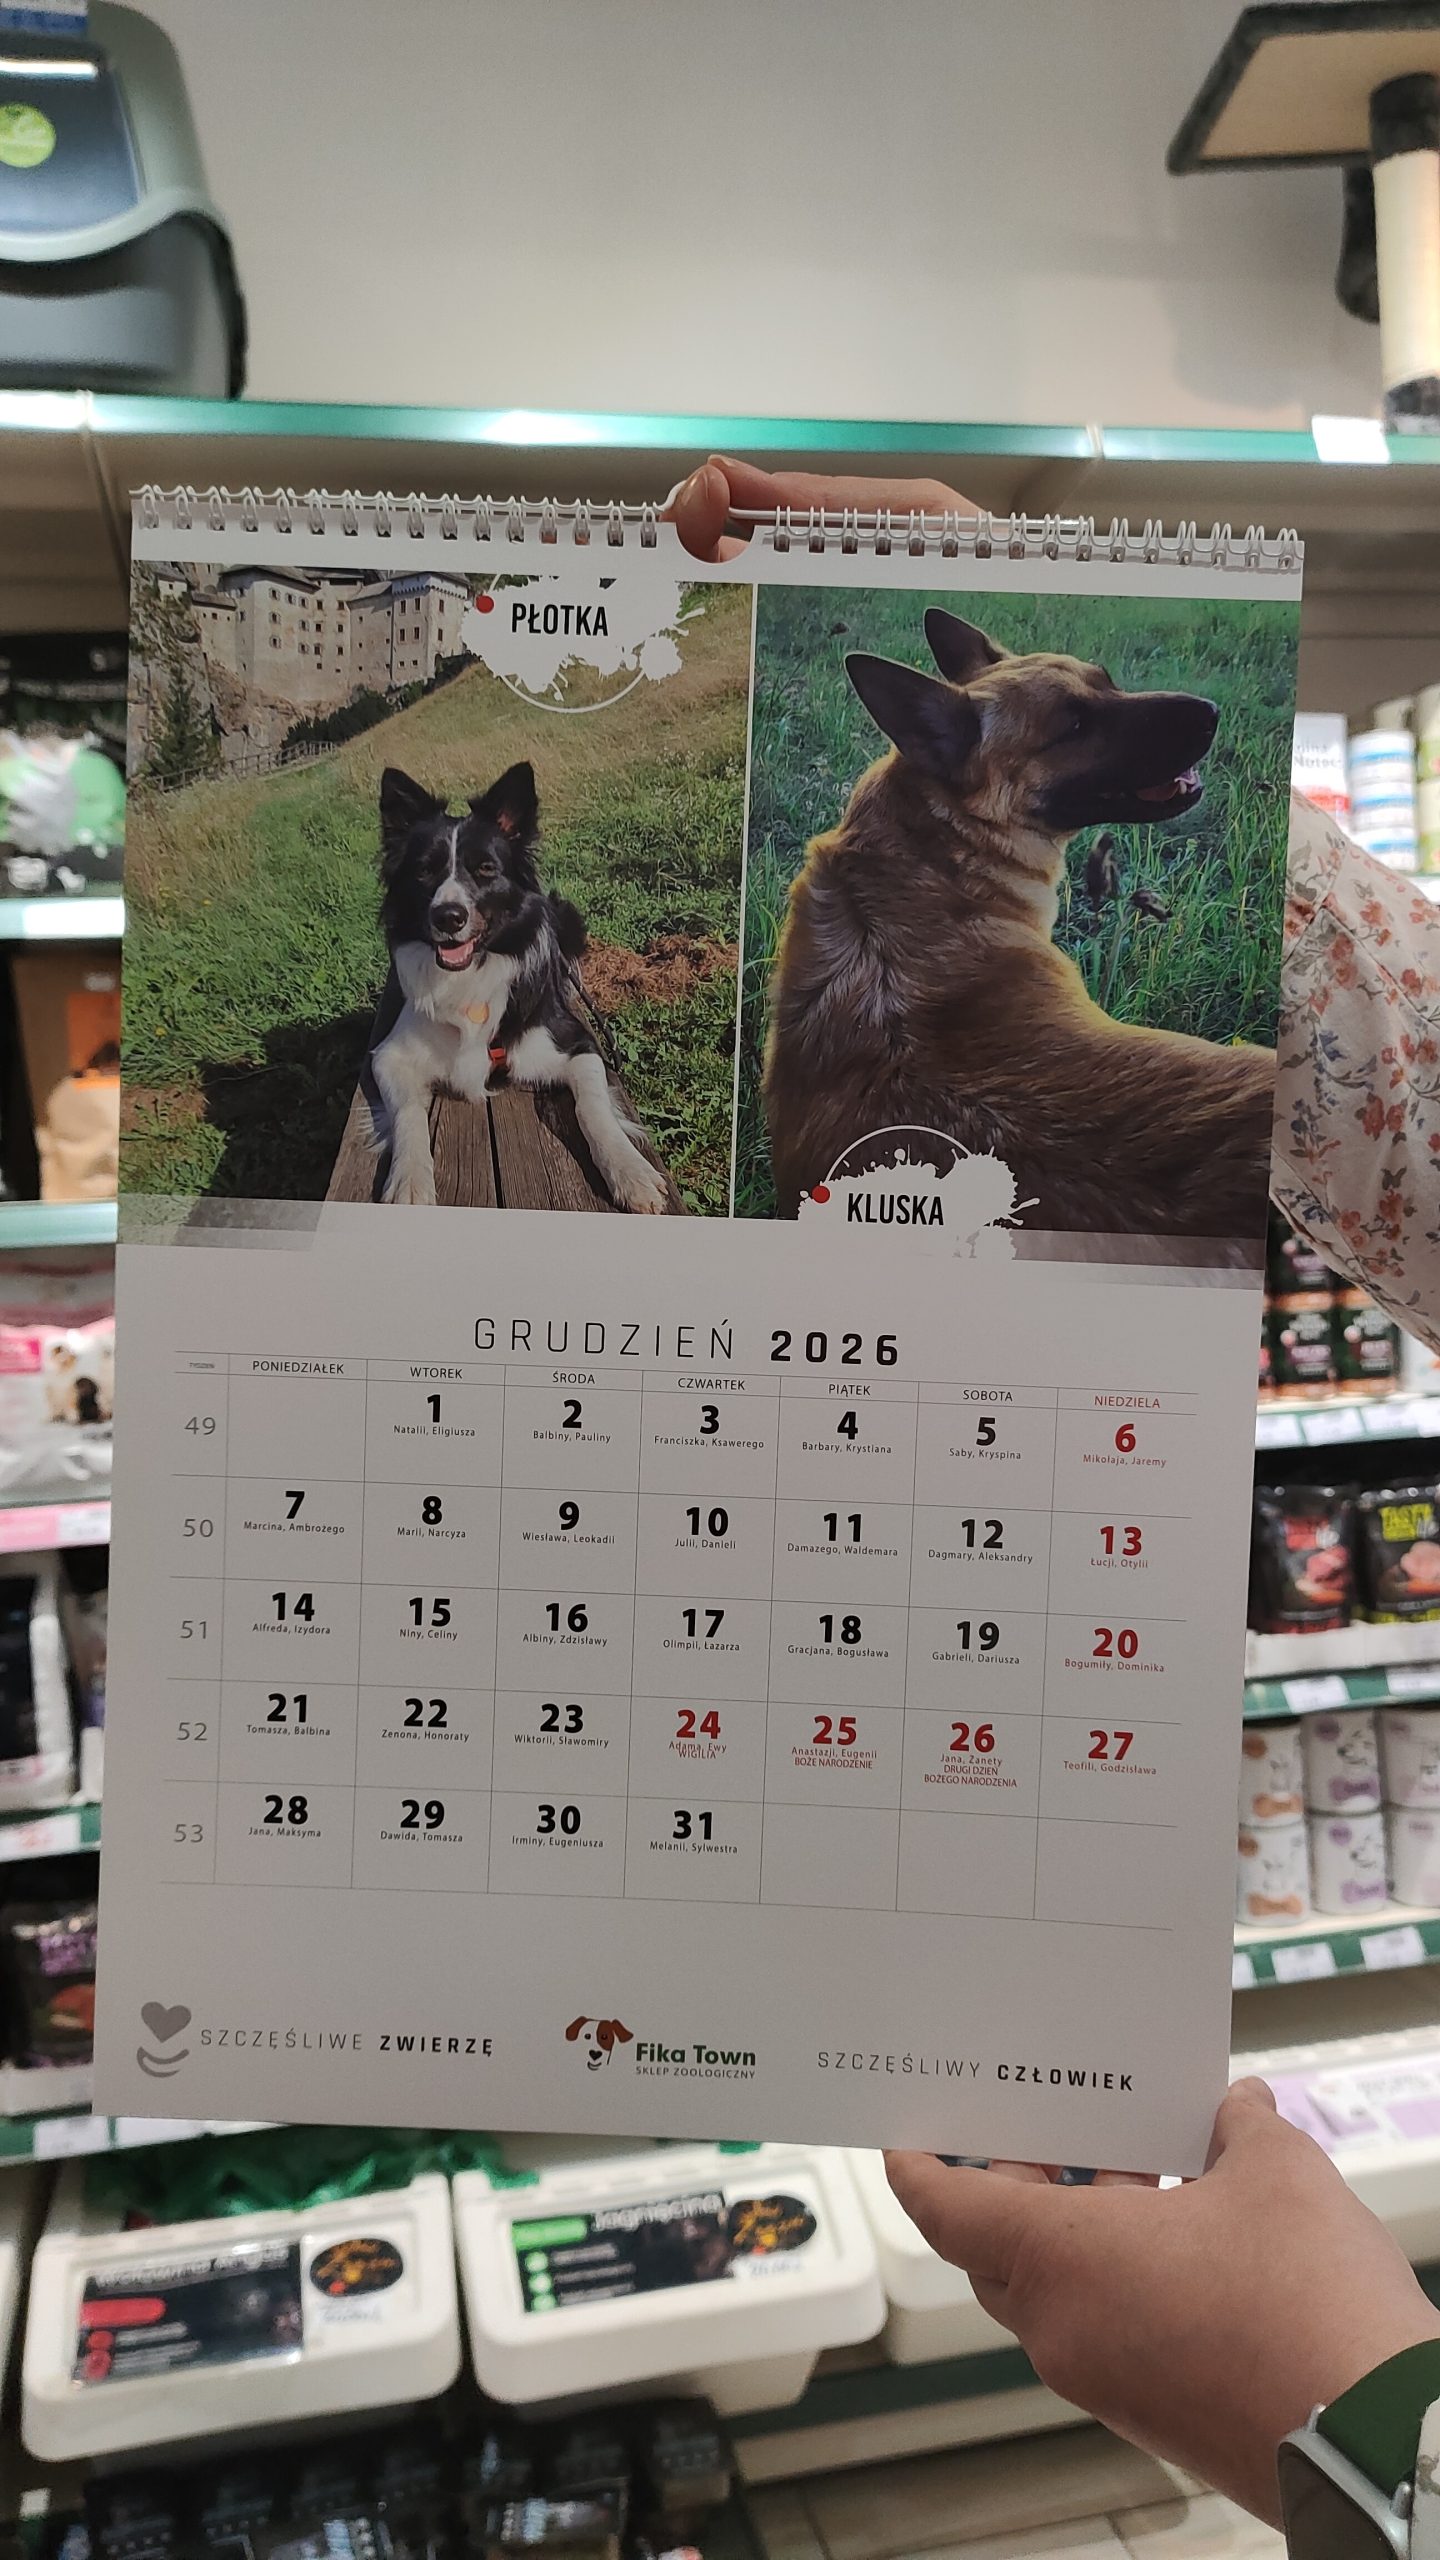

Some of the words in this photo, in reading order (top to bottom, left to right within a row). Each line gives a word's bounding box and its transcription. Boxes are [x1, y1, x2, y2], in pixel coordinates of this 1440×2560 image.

[512, 603, 608, 636] PŁOTKA
[848, 1193, 944, 1225] KLUSKA
[475, 1318, 732, 1359] GRUDZIEŃ
[771, 1330, 897, 1365] 2026
[253, 1361, 343, 1374] PONIEDZIAŁEK
[410, 1367, 462, 1379] WTOREK
[553, 1371, 595, 1384] ŚRODA
[678, 1378, 745, 1390] CZWARTEK
[828, 1383, 871, 1397] PIĄTEK
[963, 1390, 1012, 1401] SOBOTA
[427, 1394, 440, 1423] 1
[1095, 1396, 1160, 1408] NIEDZIELA
[563, 1400, 582, 1428] 2
[700, 1405, 719, 1434] 3
[184, 1417, 215, 1435] 49
[394, 1425, 428, 1435] Natalii,
[433, 1426, 475, 1437] Eligiusza
[837, 1411, 858, 1440] 4
[976, 1417, 996, 1446] 5
[534, 1431, 571, 1442] Balbiny,
[576, 1432, 610, 1443] Pauliny
[655, 1436, 707, 1447] Franciszka,
[712, 1438, 764, 1449] Ksawerego
[1115, 1424, 1136, 1452] 6
[803, 1442, 842, 1453] Barbary,
[846, 1444, 891, 1454] Krystiana
[950, 1448, 974, 1459] Saby,
[979, 1449, 1021, 1460] Kryspina
[1083, 1454, 1127, 1466] Mikołaja,
[1132, 1457, 1166, 1468] Jaremy
[286, 1491, 305, 1519] 7
[422, 1496, 442, 1525] 8
[559, 1501, 579, 1530] 9
[686, 1507, 728, 1536] 10
[183, 1519, 213, 1537] 50
[244, 1521, 285, 1531] Marcina,
[398, 1527, 424, 1537] Marii,
[429, 1528, 465, 1539] Narcyza
[824, 1513, 861, 1542] 11
[523, 1532, 569, 1543] Wiesława,
[574, 1534, 614, 1544] Leokadii
[962, 1519, 1003, 1549] 12
[1100, 1526, 1141, 1556] 13
[675, 1538, 697, 1548] Julii,
[702, 1540, 735, 1549] Danieli
[788, 1543, 840, 1555] Damazego,
[844, 1546, 897, 1556] Waldemara
[929, 1550, 974, 1561] Dagmary,
[979, 1552, 1032, 1564] Aleksandry
[1091, 1558, 1116, 1568] Łucji,
[1121, 1559, 1147, 1570] Otylii
[272, 1592, 315, 1621] 14
[409, 1598, 450, 1627] 15
[546, 1603, 588, 1632] 16
[683, 1609, 724, 1638] 17
[180, 1621, 206, 1639] 51
[252, 1623, 291, 1634] Alfreda,
[295, 1625, 330, 1635] Izydora
[400, 1629, 423, 1639] Niny,
[428, 1630, 457, 1641] Celiny
[819, 1615, 861, 1644] 18
[957, 1621, 999, 1650] 19
[523, 1634, 556, 1645] Albiny,
[560, 1635, 607, 1647] Zdzisławy
[663, 1640, 700, 1650] Olimpii,
[705, 1641, 739, 1650] Łazarza
[1093, 1628, 1138, 1658] 20
[788, 1645, 833, 1656] Gracjana,
[837, 1647, 888, 1658] Bogusława
[932, 1652, 973, 1663] Gabrieli,
[978, 1654, 1019, 1664] Dariusza
[1065, 1658, 1113, 1671] Bogumiły,
[1118, 1661, 1164, 1672] Dominika
[267, 1693, 307, 1723] 21
[404, 1698, 447, 1728] 22
[540, 1704, 583, 1733] 23
[676, 1710, 721, 1739] 24
[177, 1722, 207, 1741] 52
[247, 1725, 290, 1735] Tomasza,
[295, 1726, 330, 1735] Balbina
[382, 1729, 420, 1740] Zenona,
[425, 1731, 469, 1742] Honoraty
[813, 1715, 856, 1745] 25
[515, 1734, 555, 1745] Wiktorii,
[559, 1736, 608, 1748] Sławomiry
[950, 1722, 995, 1753] 26
[709, 1743, 726, 1753] Ewy
[1088, 1730, 1133, 1760] 27
[679, 1748, 716, 1759] WIGILIA
[792, 1747, 838, 1758] Anastazji,
[842, 1749, 877, 1759] Eugenii
[940, 1754, 965, 1764] Jana,
[795, 1757, 816, 1766] BOŻE
[819, 1759, 872, 1769] NARODZENIE
[944, 1765, 970, 1774] DRUGI
[1064, 1761, 1096, 1772] Teofili,
[1101, 1763, 1156, 1774] Godzisława
[961, 1777, 1017, 1787] NARODZENIA
[264, 1795, 308, 1825] 28
[400, 1800, 444, 1829] 29
[537, 1805, 580, 1834] 30
[673, 1810, 712, 1840] 31
[174, 1824, 203, 1843] 53
[248, 1827, 273, 1837] Jana,
[277, 1828, 321, 1838] Maksyma
[381, 1831, 419, 1841] Dawida,
[423, 1832, 462, 1842] Tomasza
[513, 1835, 545, 1847] Irminy,
[550, 1837, 603, 1848] Eugeniusza
[650, 1841, 687, 1852] Melanii,
[692, 1843, 737, 1854] Sylwestra
[201, 2028, 361, 2050] SZCZĘŚLIWE
[380, 2035, 492, 2057] ZWIERZĘ
[636, 2043, 685, 2063] Fika
[693, 2045, 755, 2066] Town
[636, 2066, 669, 2075] SKLEP
[674, 2068, 755, 2079] ZOOLOGICZNY
[818, 2052, 979, 2078] SZCZĘŚLIWY
[998, 2065, 1132, 2091] CZŁOWIEK
